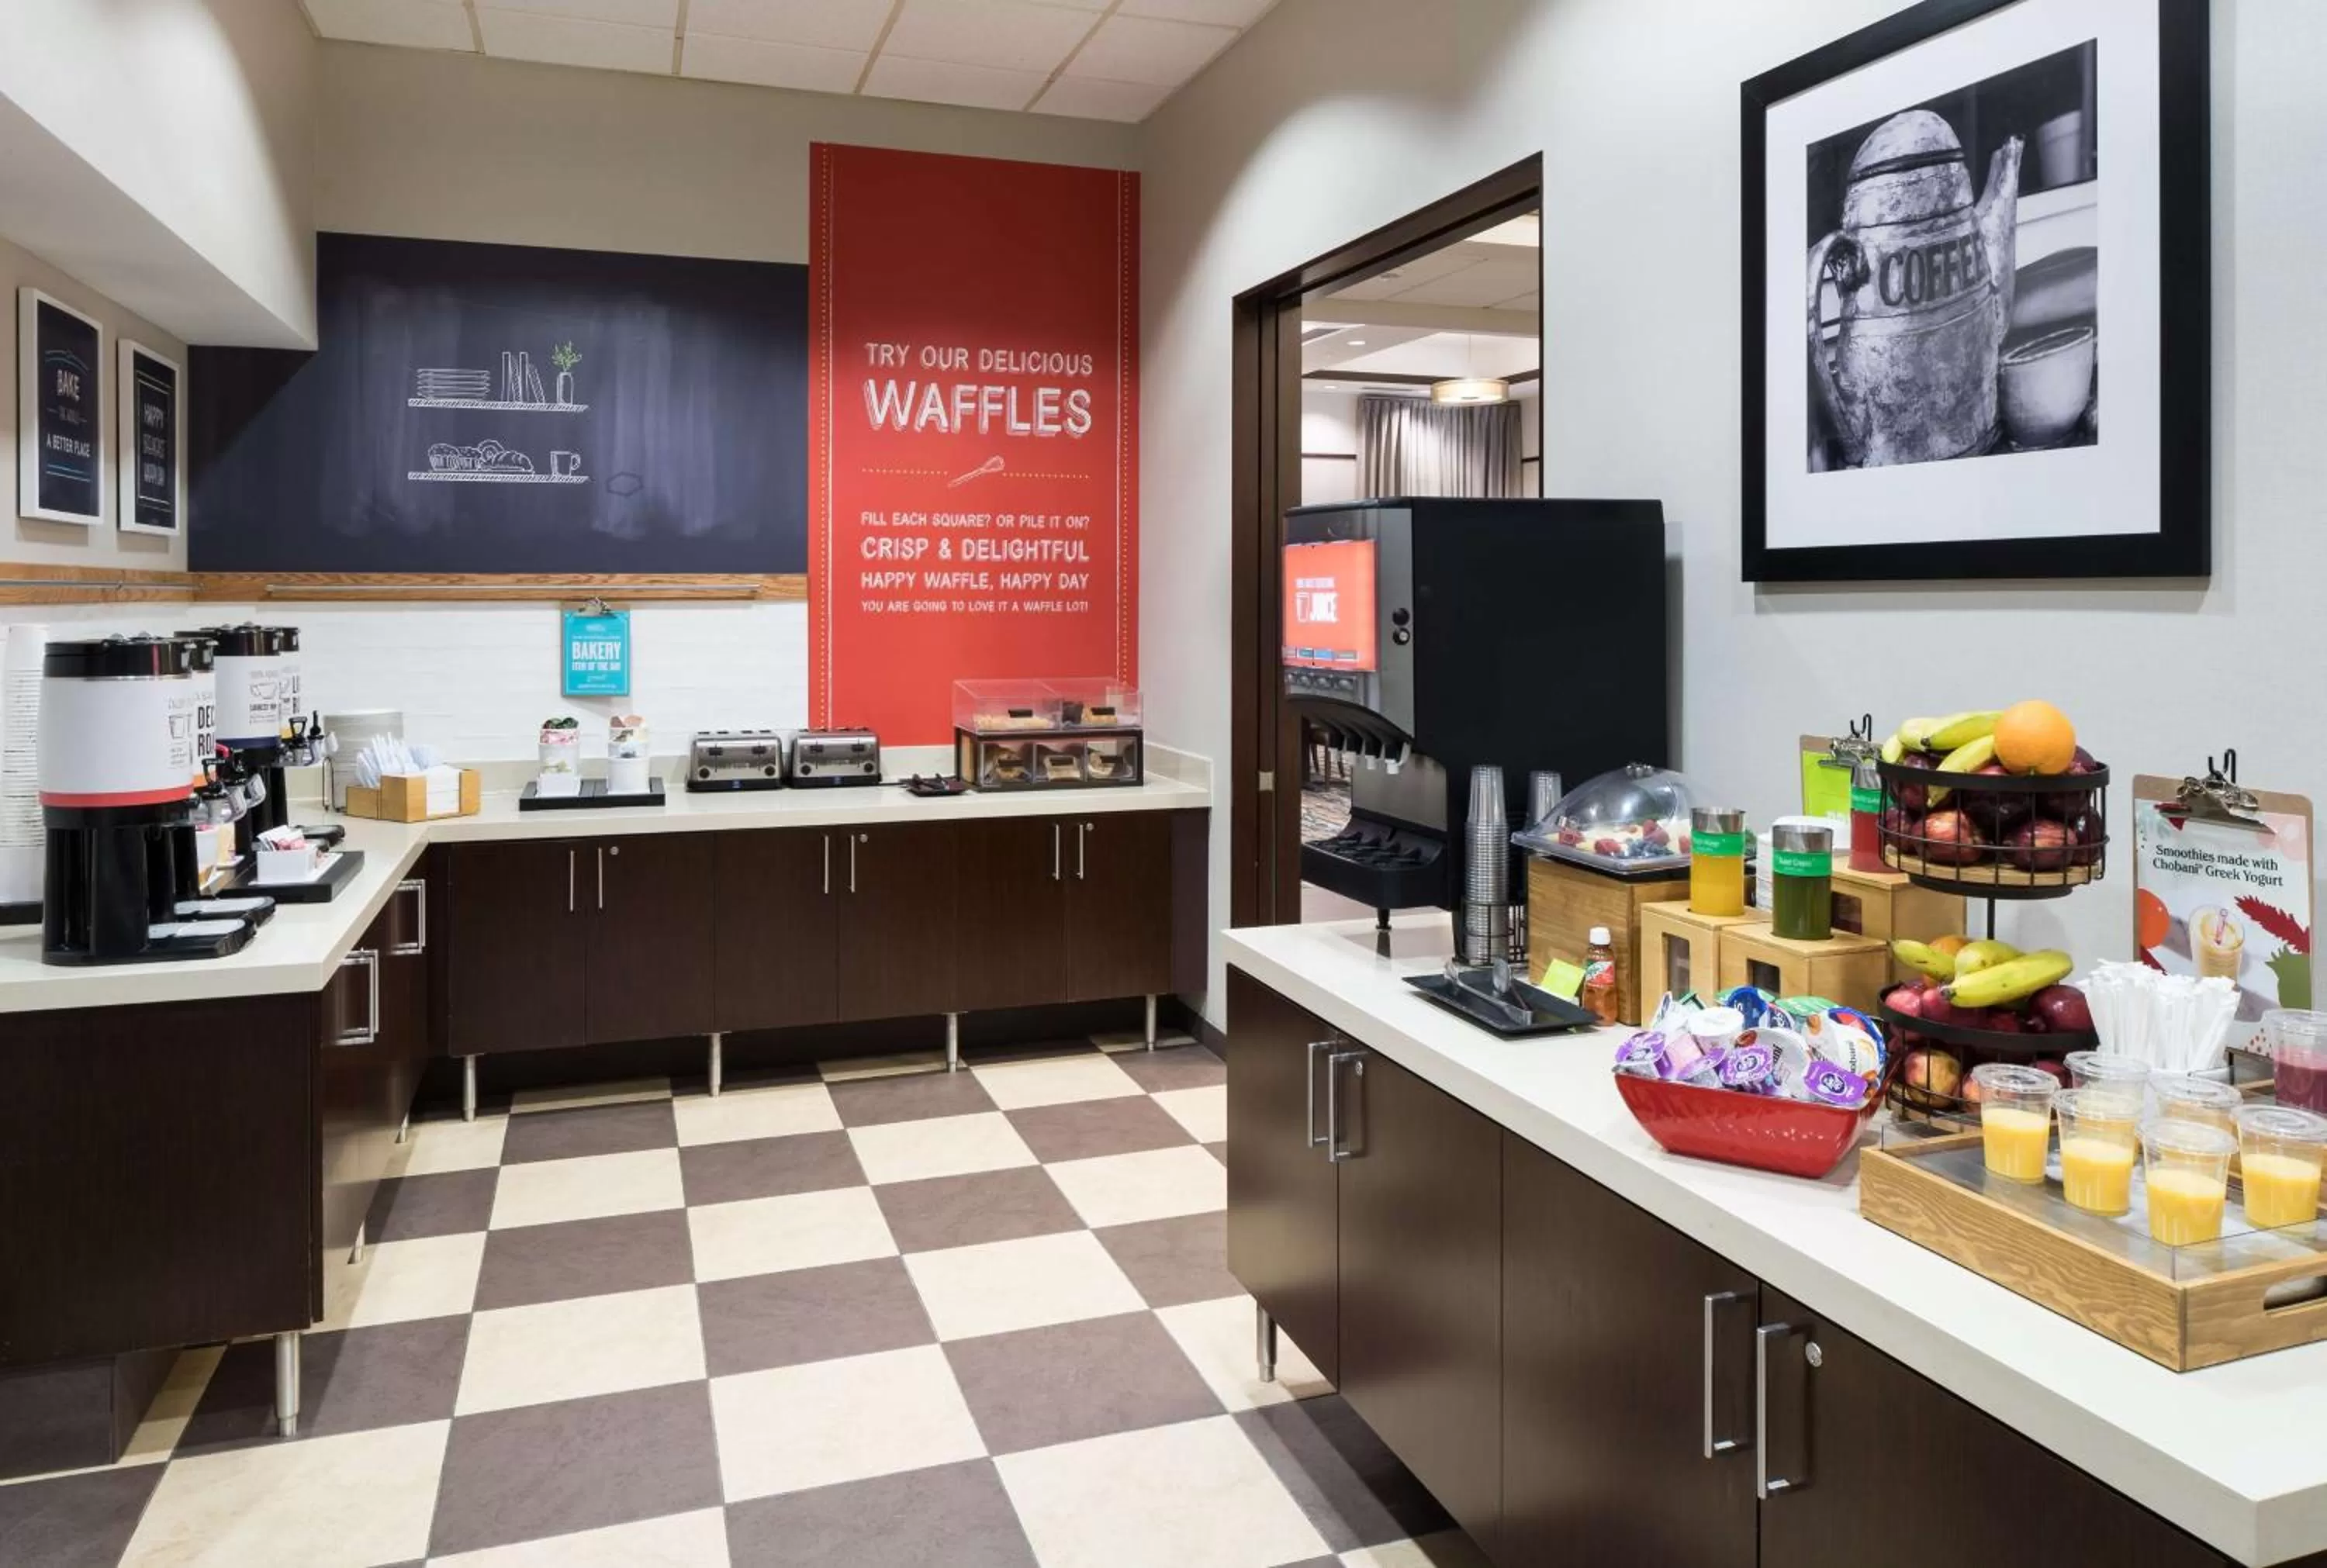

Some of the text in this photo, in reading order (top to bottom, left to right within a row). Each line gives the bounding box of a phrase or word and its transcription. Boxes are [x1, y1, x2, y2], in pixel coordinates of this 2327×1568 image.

[865, 343, 1093, 376] TRY OUR DELICIOUS
[57, 369, 80, 402] BAKE
[863, 378, 1092, 439] WAFFLES
[860, 511, 1090, 530] FILL EACH SQUARE? OR PILE IT ON?
[861, 536, 1090, 563] CRISP & DELIGHTFUL
[861, 572, 1089, 591] HAPPY WAFFLE, HAPPY DAY
[862, 600, 883, 613] YOU
[887, 601, 909, 613] ARE
[913, 600, 947, 613] GOING
[952, 601, 965, 613] TO
[969, 601, 994, 613] LOVE
[998, 601, 1007, 613] IT
[1011, 601, 1019, 613] A
[1023, 601, 1063, 613] WAFFLE
[572, 642, 621, 660] BAKERY
[2156, 844, 2279, 872] Smoothies made with
[2205, 865, 2241, 881] Greek
[2243, 869, 2284, 887] Yogurt
